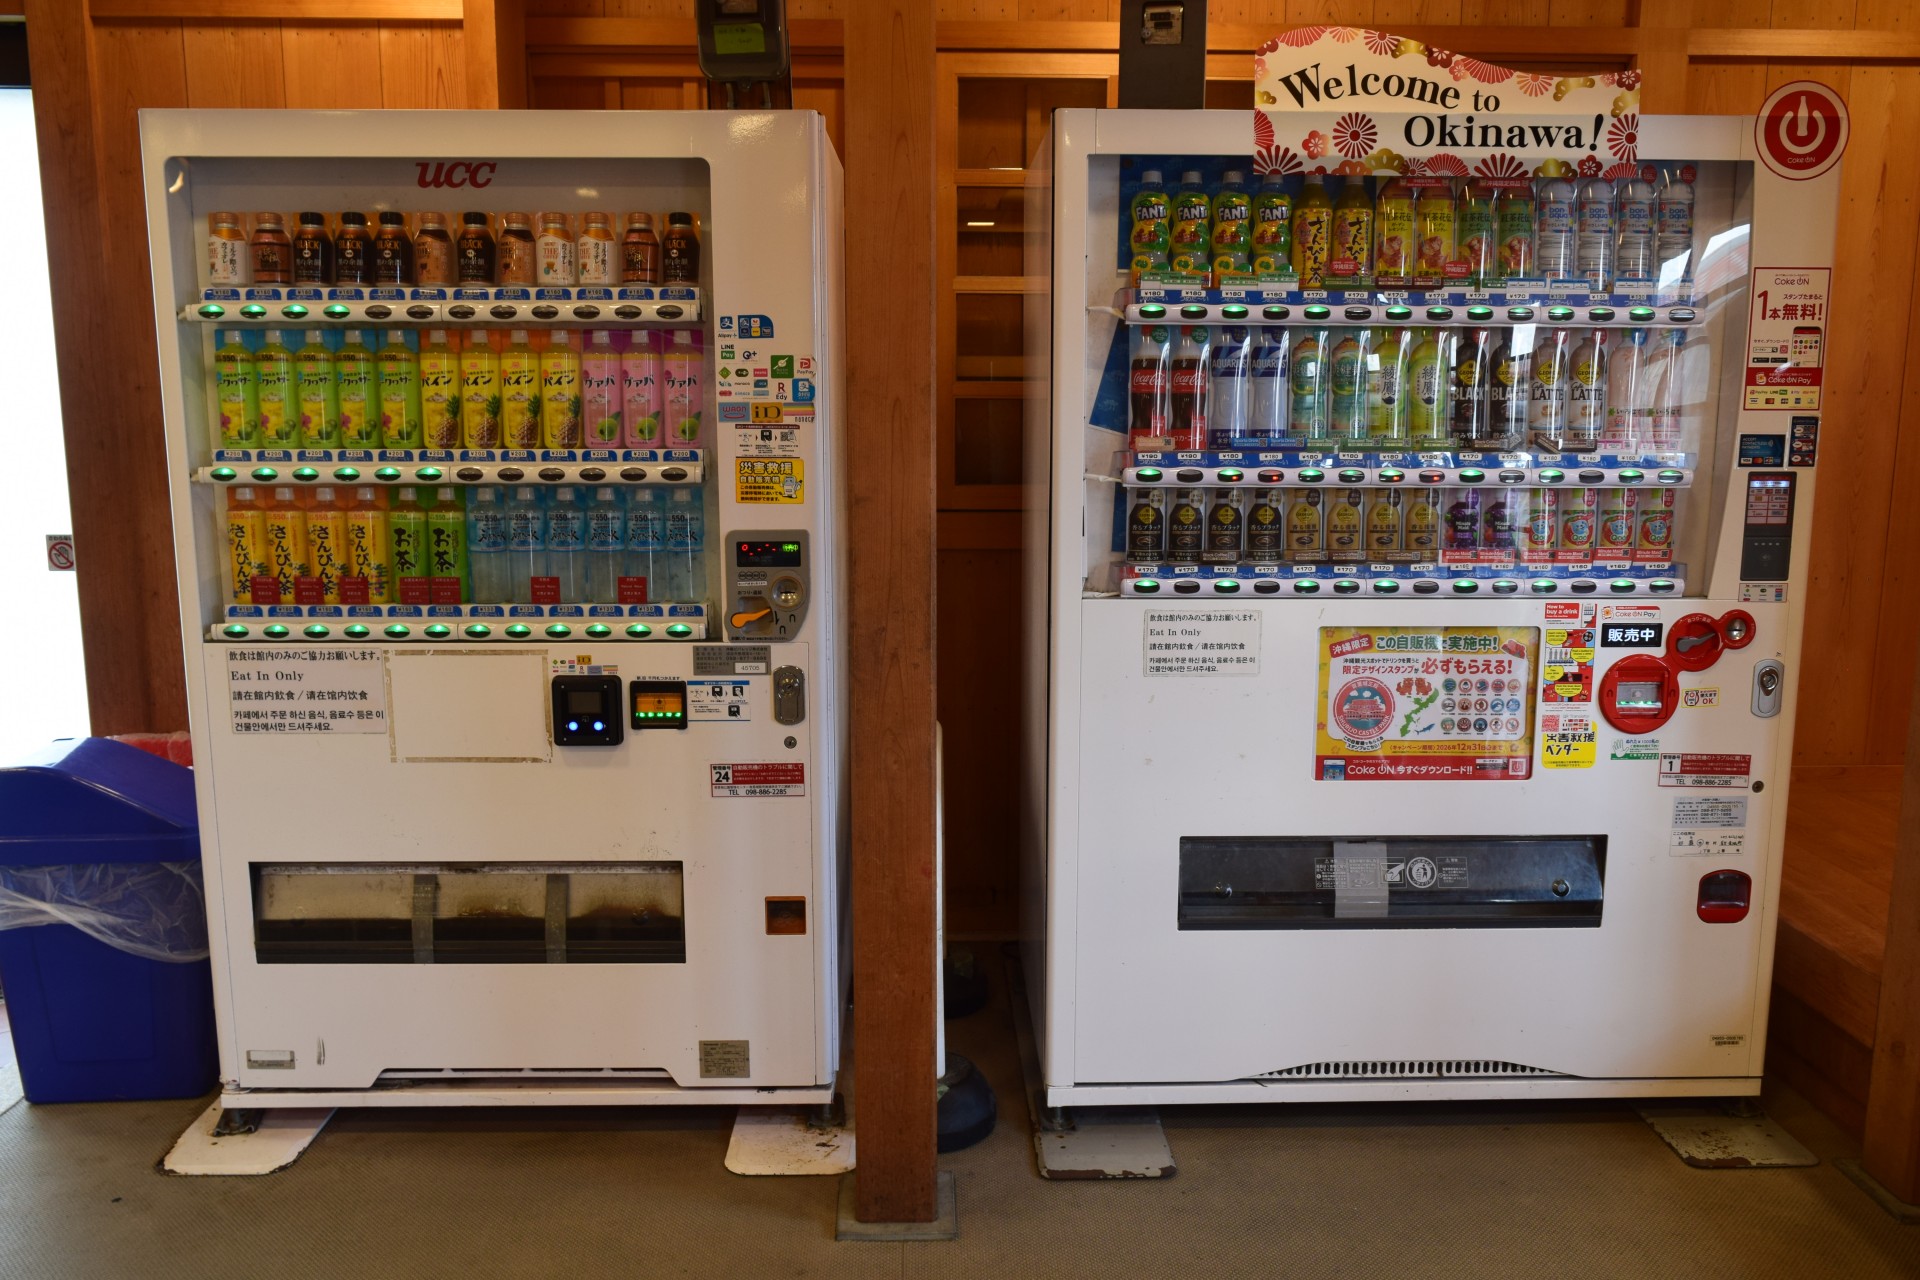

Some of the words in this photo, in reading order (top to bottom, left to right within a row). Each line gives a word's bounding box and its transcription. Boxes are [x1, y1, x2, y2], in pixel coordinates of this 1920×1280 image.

[1278, 62, 1460, 110] Welcome
[1473, 89, 1500, 113] to
[1403, 113, 1605, 152] Okinawa!
[1307, 217, 1325, 284] さんぴん茶
[1774, 278, 1796, 286] Coke
[1757, 290, 1823, 321] 1本無料!
[422, 375, 452, 387] パイン
[462, 375, 493, 387] パイン
[503, 375, 534, 387] パイン
[544, 375, 574, 387] パイン
[1382, 364, 1396, 396] 綾鷹
[1421, 364, 1436, 396] 綾鷹
[1798, 377, 1812, 386] Pay
[1532, 389, 1564, 401] LATTE
[1571, 389, 1603, 401] LATTE
[755, 406, 781, 419] iD
[739, 461, 793, 475] 災害救援
[515, 514, 528, 522] 550
[595, 514, 608, 522] 550
[1532, 533, 1547, 542] Qoo
[1572, 533, 1587, 542] Qoo
[1611, 533, 1626, 542] Qoo
[1650, 533, 1665, 542] Qoo
[393, 527, 415, 573] お茶
[433, 527, 455, 573] お茶
[234, 524, 251, 595] さんぴん茶
[274, 524, 293, 595] さんぴん茶
[1149, 613, 1257, 622] 飲食は館内のみのご協力お願いします。
[1149, 628, 1164, 636] Eat
[1168, 628, 1177, 636] In
[1181, 628, 1202, 637] Only
[1608, 627, 1655, 642] 販売中
[1331, 636, 1372, 656] 沖縄限定
[229, 650, 381, 662] 飲食は館内のみのご協力お願いします。
[1342, 664, 1420, 675] 限定デザインスタンプが
[1420, 656, 1513, 675] 必ずもらえる!
[231, 671, 252, 681] Eat
[257, 671, 270, 681] In
[275, 671, 304, 682] Only
[234, 710, 268, 720] 카페에서
[270, 710, 287, 720] 주문
[289, 710, 306, 720] 하신
[329, 710, 355, 720] 음료수
[375, 711, 384, 719] 이
[235, 722, 286, 732] 건물안에서만
[1546, 743, 1580, 756] ベンダー
[1347, 764, 1376, 775] Coke
[1377, 763, 1397, 775] ON
[1397, 764, 1474, 775] 今すぐダウンロード!!
[1668, 761, 1674, 772] 1
[715, 771, 730, 783] 24
